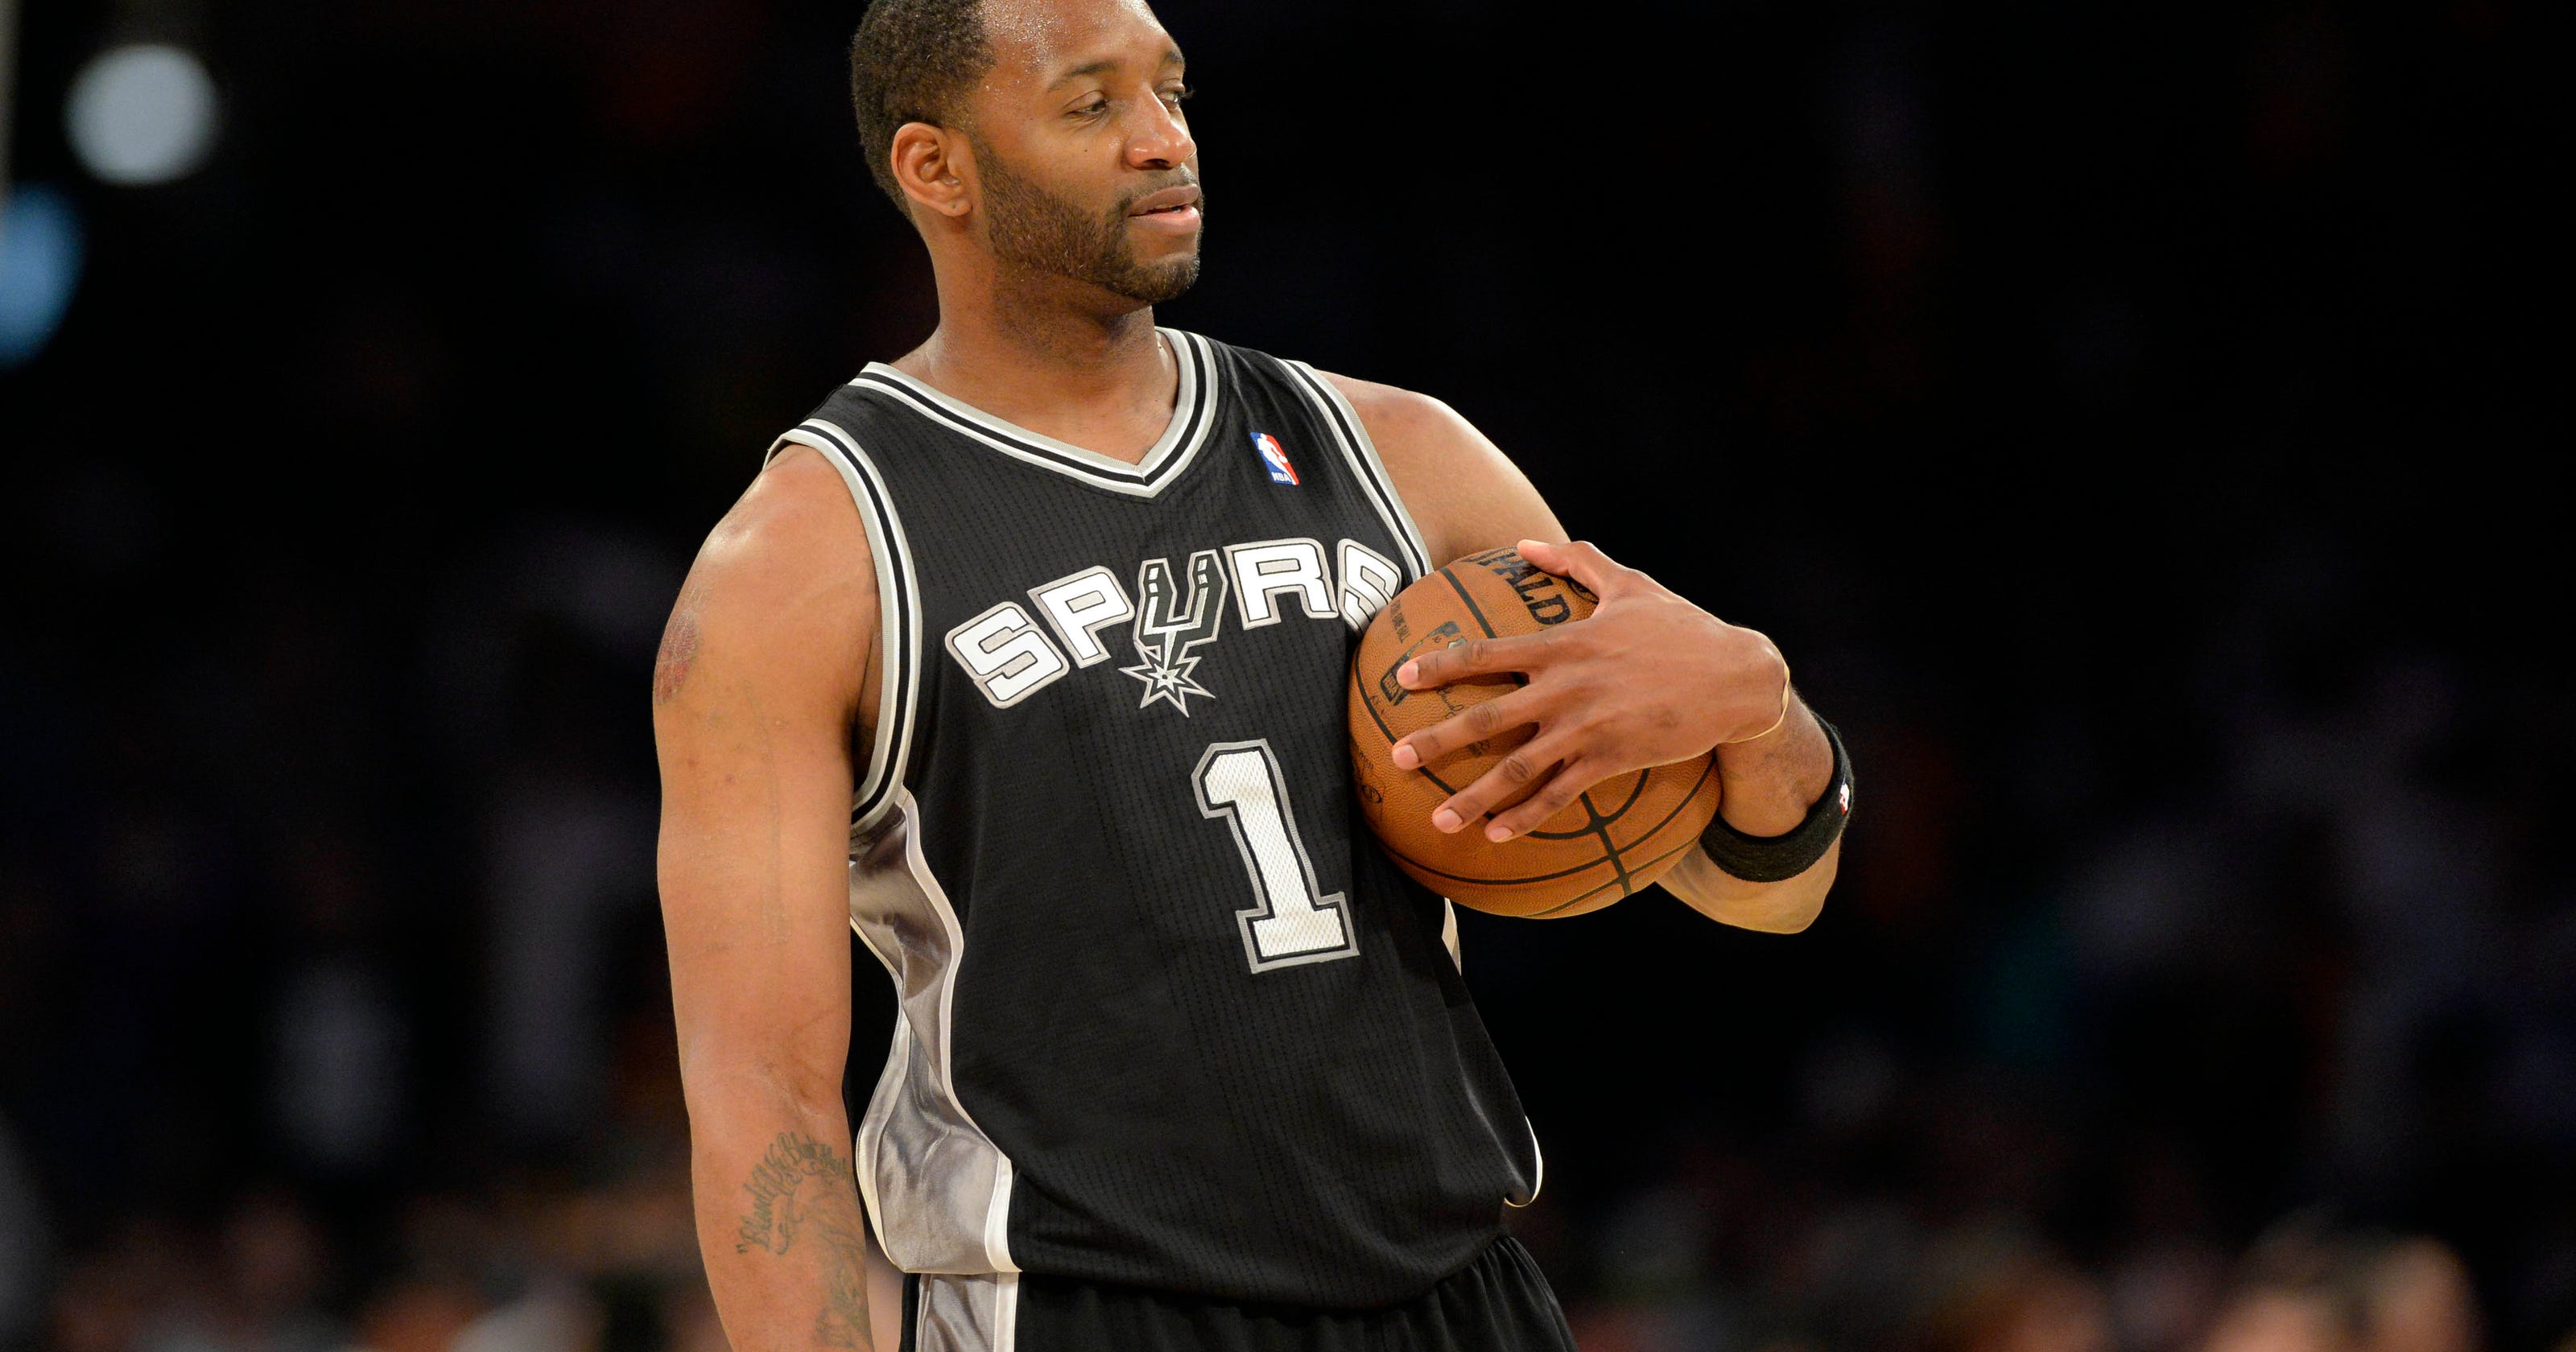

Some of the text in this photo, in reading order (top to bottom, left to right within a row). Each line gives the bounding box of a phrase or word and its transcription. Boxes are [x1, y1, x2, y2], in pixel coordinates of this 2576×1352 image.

[1271, 472, 1292, 482] NBA
[945, 538, 1402, 718] SPURS
[1191, 738, 1360, 975] 1
